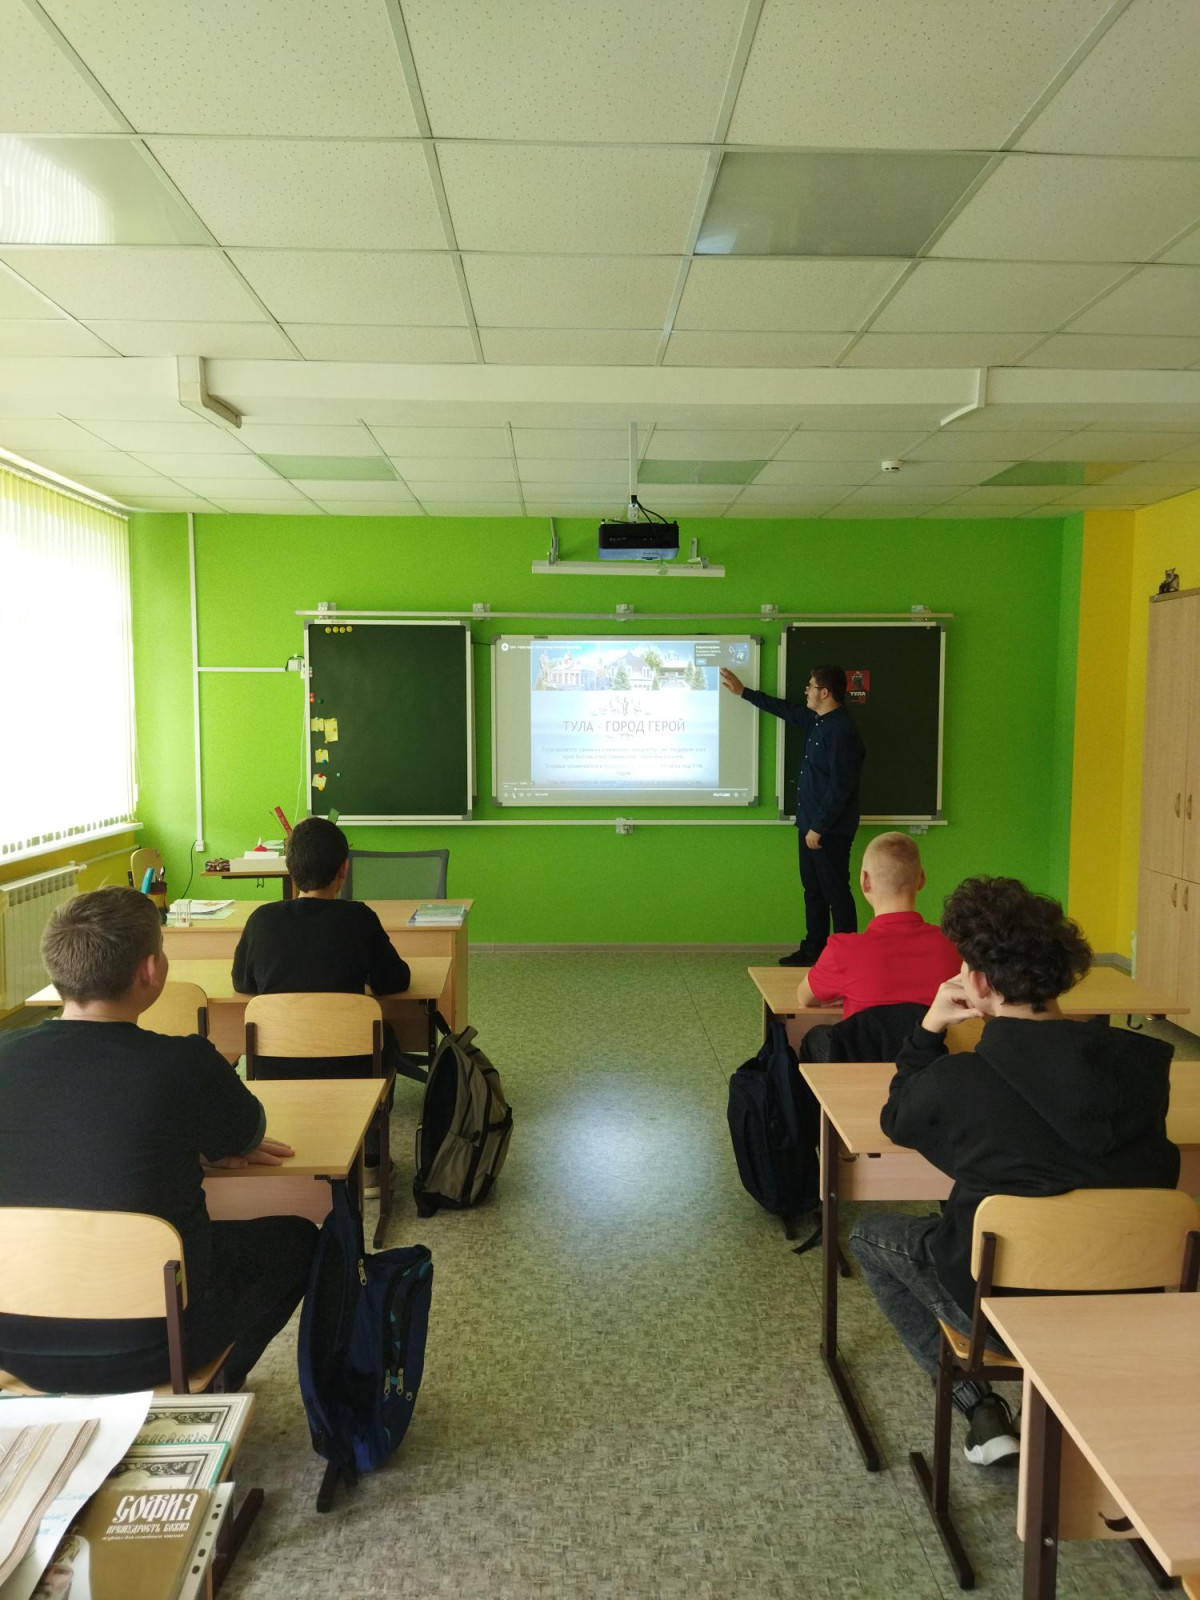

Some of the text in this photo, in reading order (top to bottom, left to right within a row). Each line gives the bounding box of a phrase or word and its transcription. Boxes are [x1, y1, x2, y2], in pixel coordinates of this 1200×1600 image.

[563, 720, 594, 732] ТУЛА
[605, 720, 645, 735] ГОРОД
[648, 718, 685, 732] ГЕРОЙ
[112, 1493, 199, 1523] СОФИЯ
